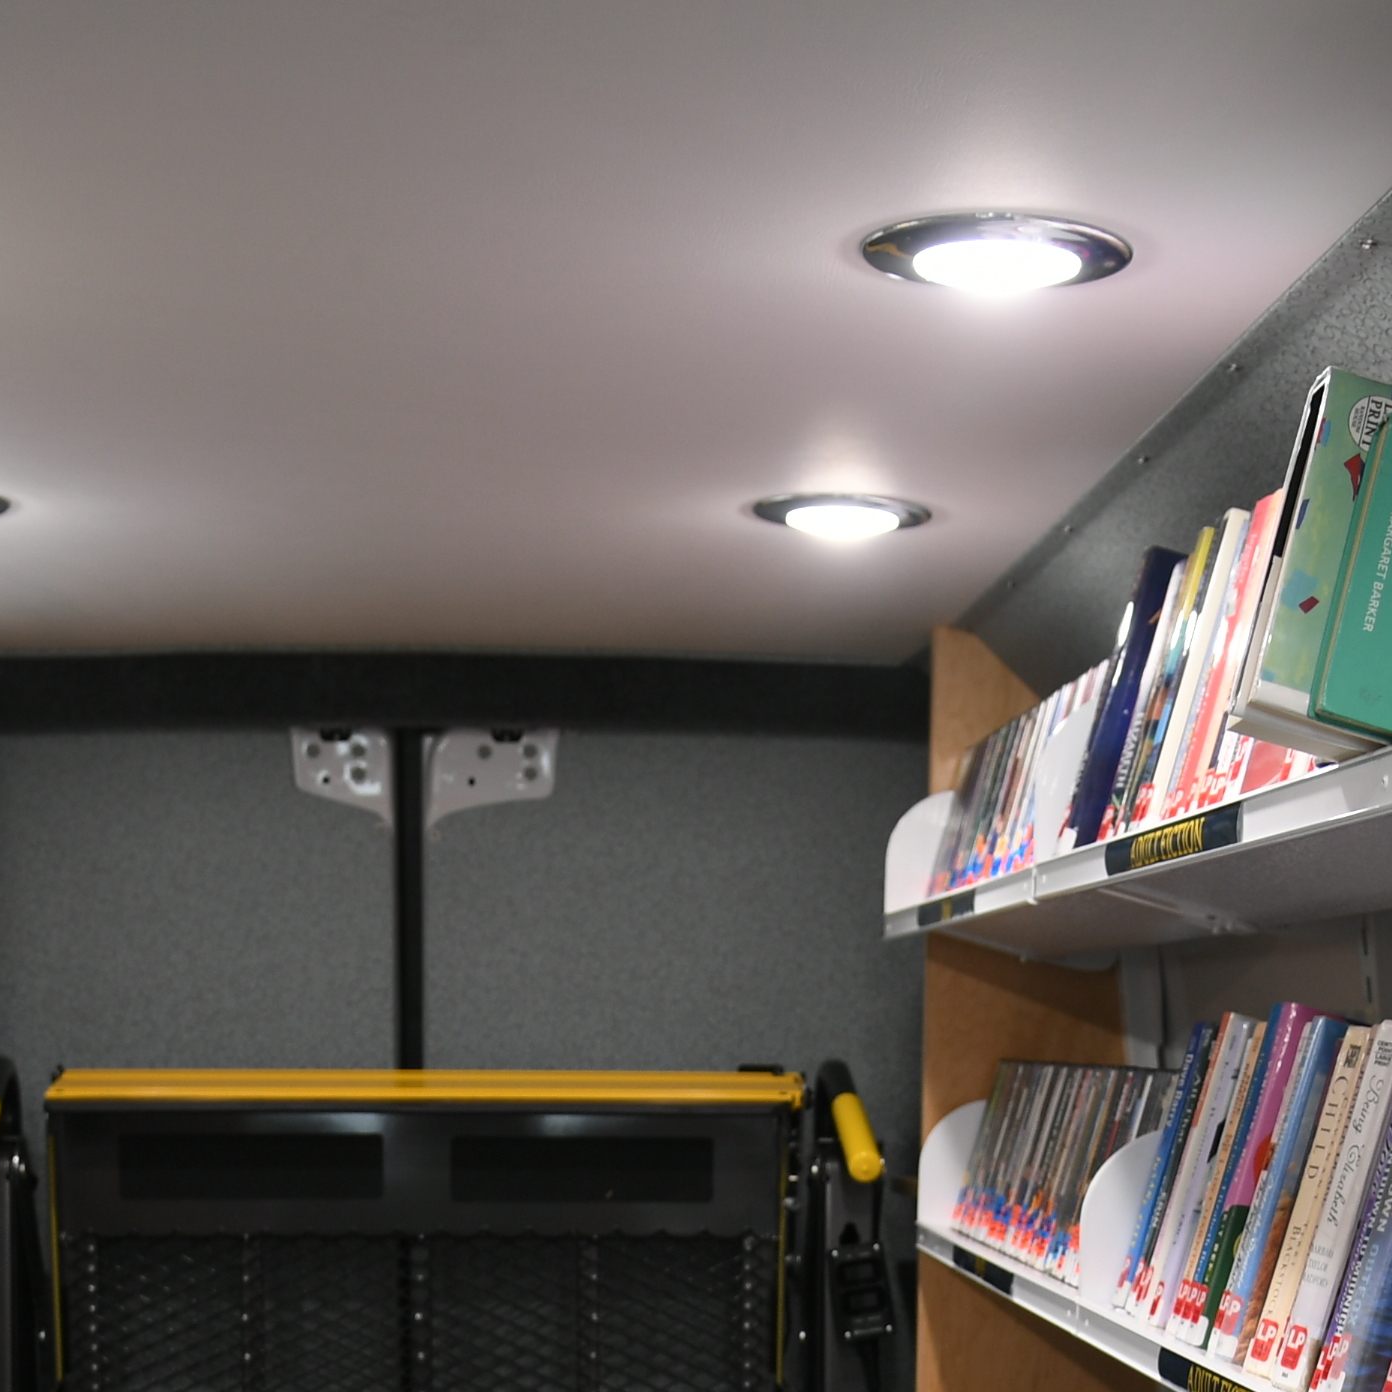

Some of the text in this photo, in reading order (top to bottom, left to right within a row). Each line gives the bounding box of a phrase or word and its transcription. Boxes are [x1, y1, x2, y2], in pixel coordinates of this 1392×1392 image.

[1363, 578, 1382, 632] BARKER
[1307, 1075, 1348, 1179] CHILD
[1327, 1143, 1367, 1227] Elizabeth
[1258, 1322, 1277, 1341] LP
[1287, 1328, 1306, 1348] LP
